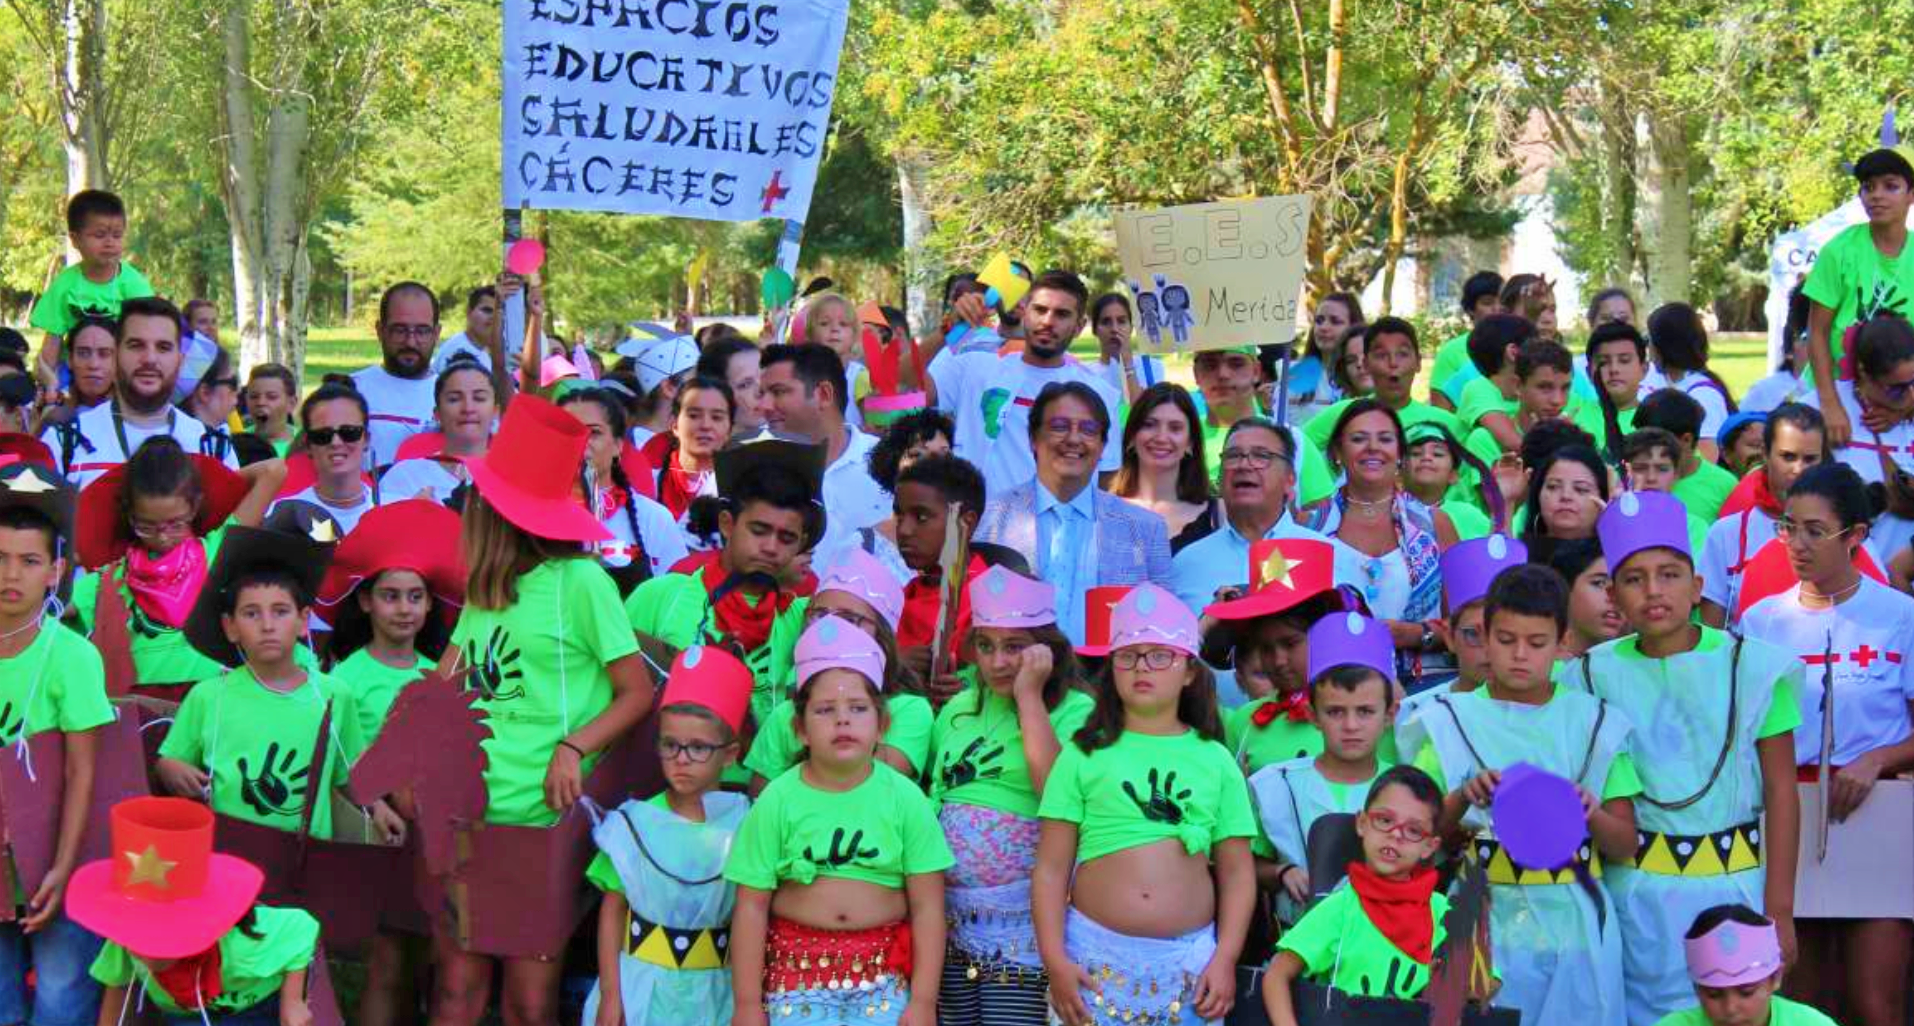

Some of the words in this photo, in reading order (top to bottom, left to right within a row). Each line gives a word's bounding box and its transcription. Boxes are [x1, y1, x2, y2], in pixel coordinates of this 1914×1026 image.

[528, 0, 780, 47] ESPACIOS
[523, 42, 833, 110] EDUCATIVOS
[519, 141, 738, 207] CÁCERES
[1204, 286, 1296, 327] Merida
